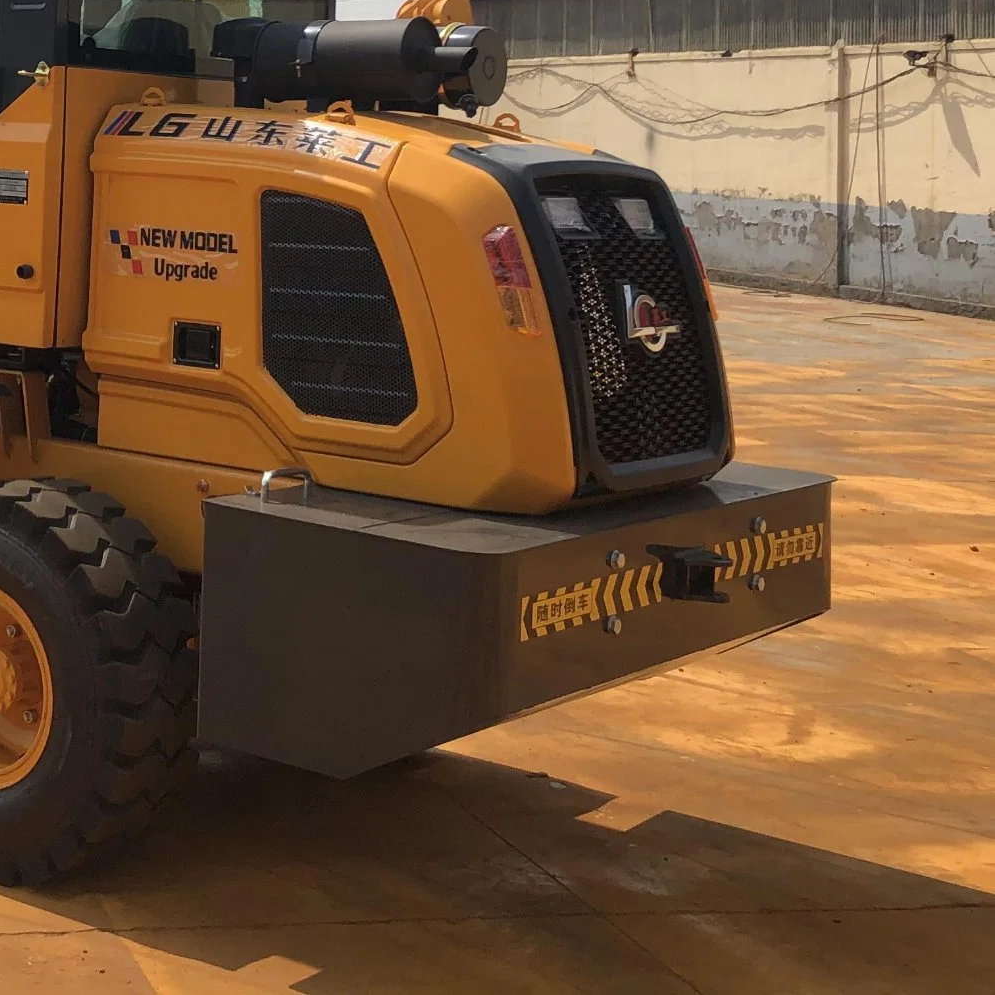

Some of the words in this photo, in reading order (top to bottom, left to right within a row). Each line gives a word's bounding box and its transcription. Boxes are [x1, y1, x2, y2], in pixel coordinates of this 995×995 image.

[200, 115, 392, 170] 山东莱工
[140, 227, 178, 248] NEW
[179, 230, 238, 254] MODEL
[153, 257, 219, 282] Upgrade
[536, 592, 590, 625] 随时倒车
